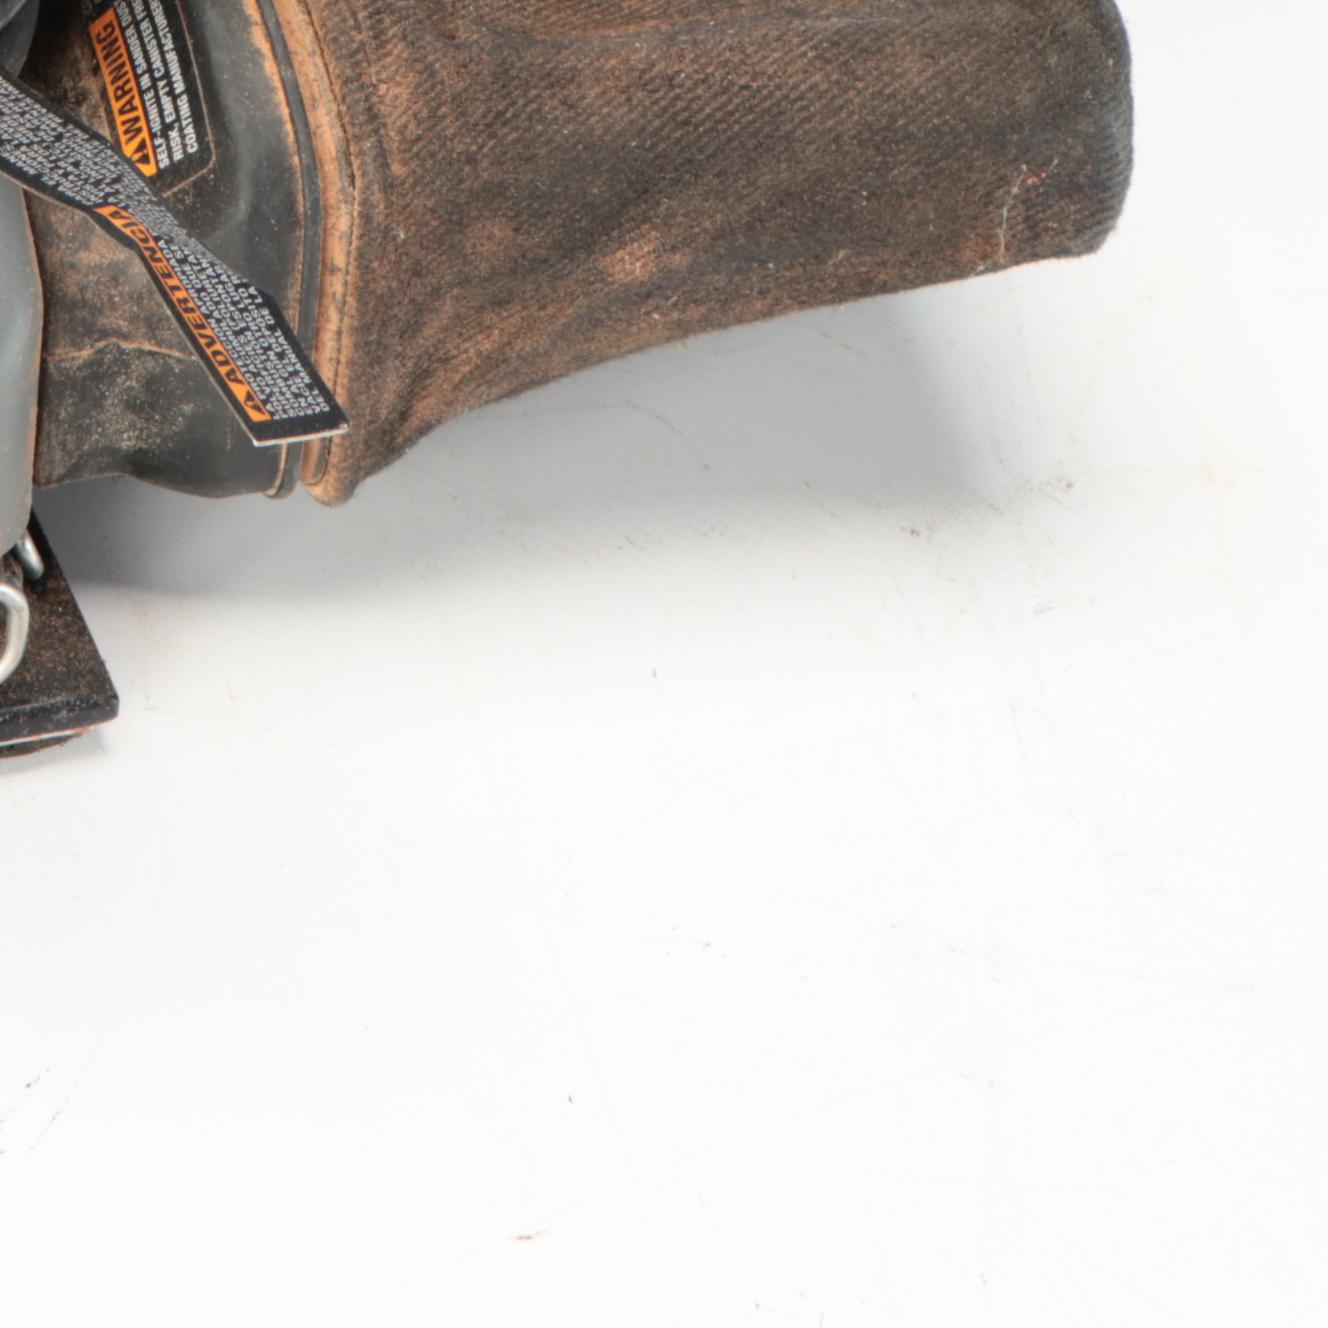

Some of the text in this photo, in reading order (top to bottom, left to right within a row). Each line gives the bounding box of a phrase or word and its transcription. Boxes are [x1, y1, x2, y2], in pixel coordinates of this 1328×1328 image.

[123, 22, 149, 72] SANDER
[138, 16, 167, 77] CANISTER
[92, 19, 145, 143] WARNING
[137, 71, 153, 89] IN
[157, 78, 178, 122] EMPTY
[141, 88, 171, 169] SELF-IGNITE
[167, 121, 185, 160] RISK,
[175, 93, 199, 153] COATING
[105, 207, 246, 387] ADVERTENCIA
